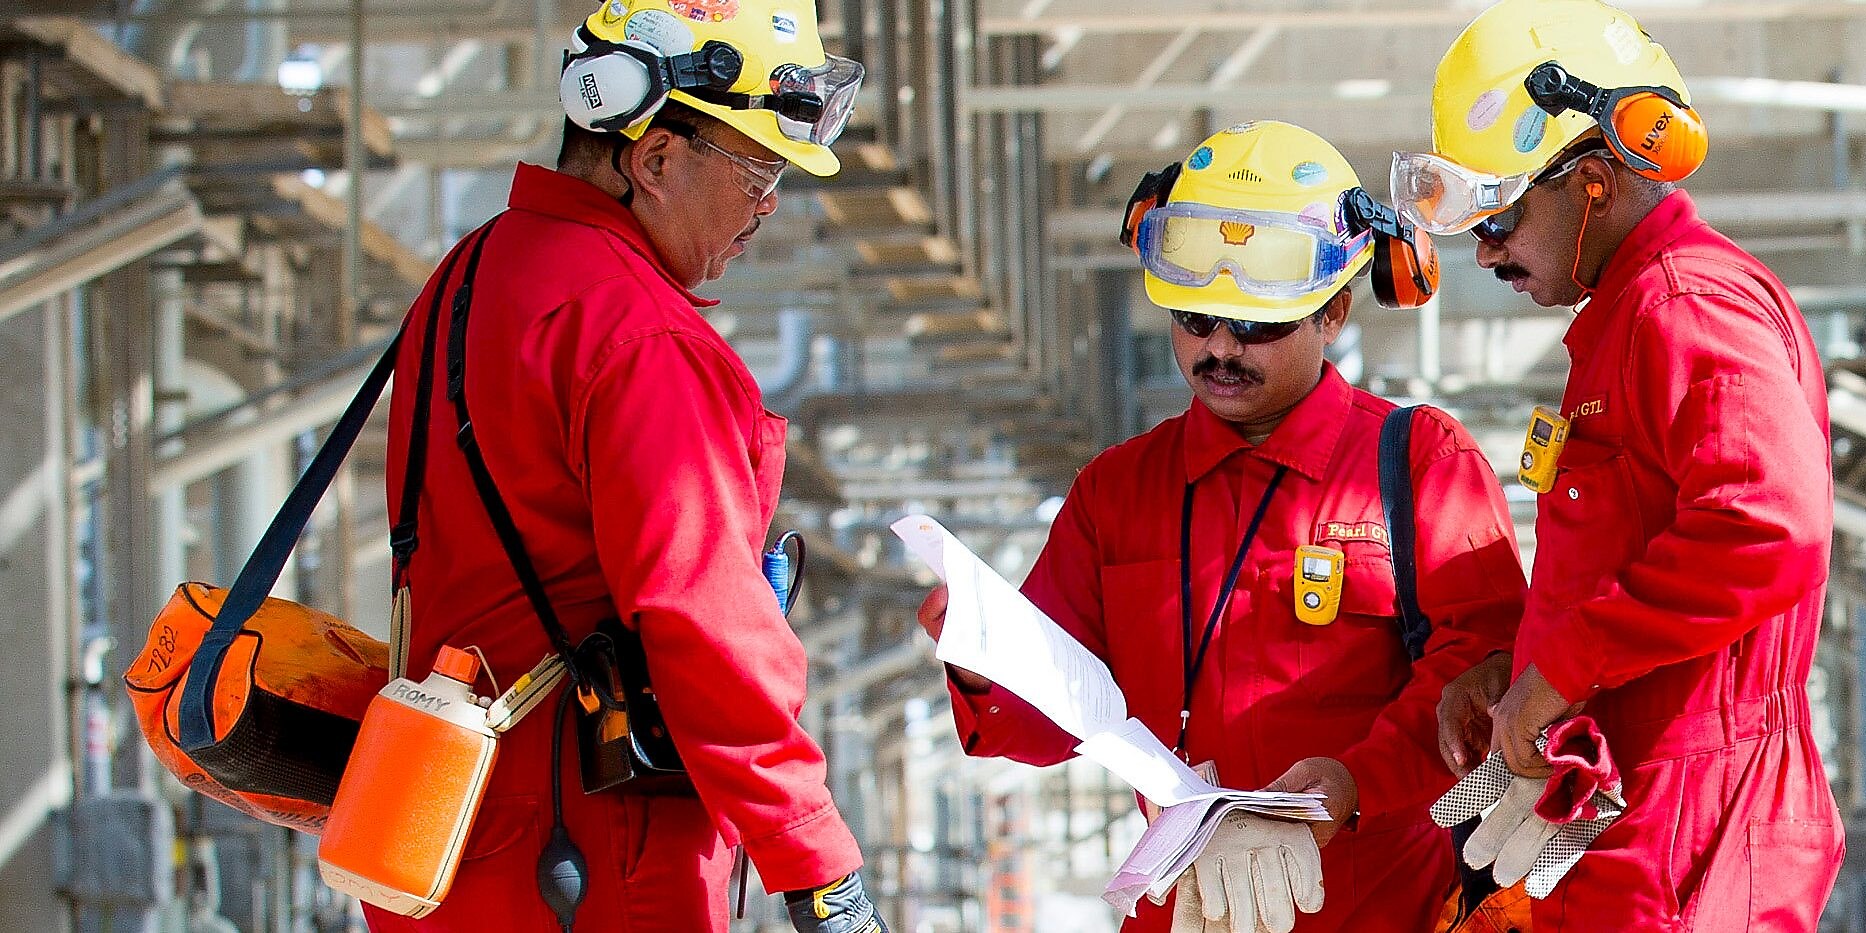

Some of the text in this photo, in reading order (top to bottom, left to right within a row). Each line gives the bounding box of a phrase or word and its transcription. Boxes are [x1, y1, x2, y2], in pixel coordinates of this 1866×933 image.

[584, 75, 601, 108] MSA
[1641, 111, 1674, 151] uvex
[1580, 399, 1603, 416] GTL
[1328, 524, 1389, 542] Pearl GT
[391, 683, 451, 713] ROMY
